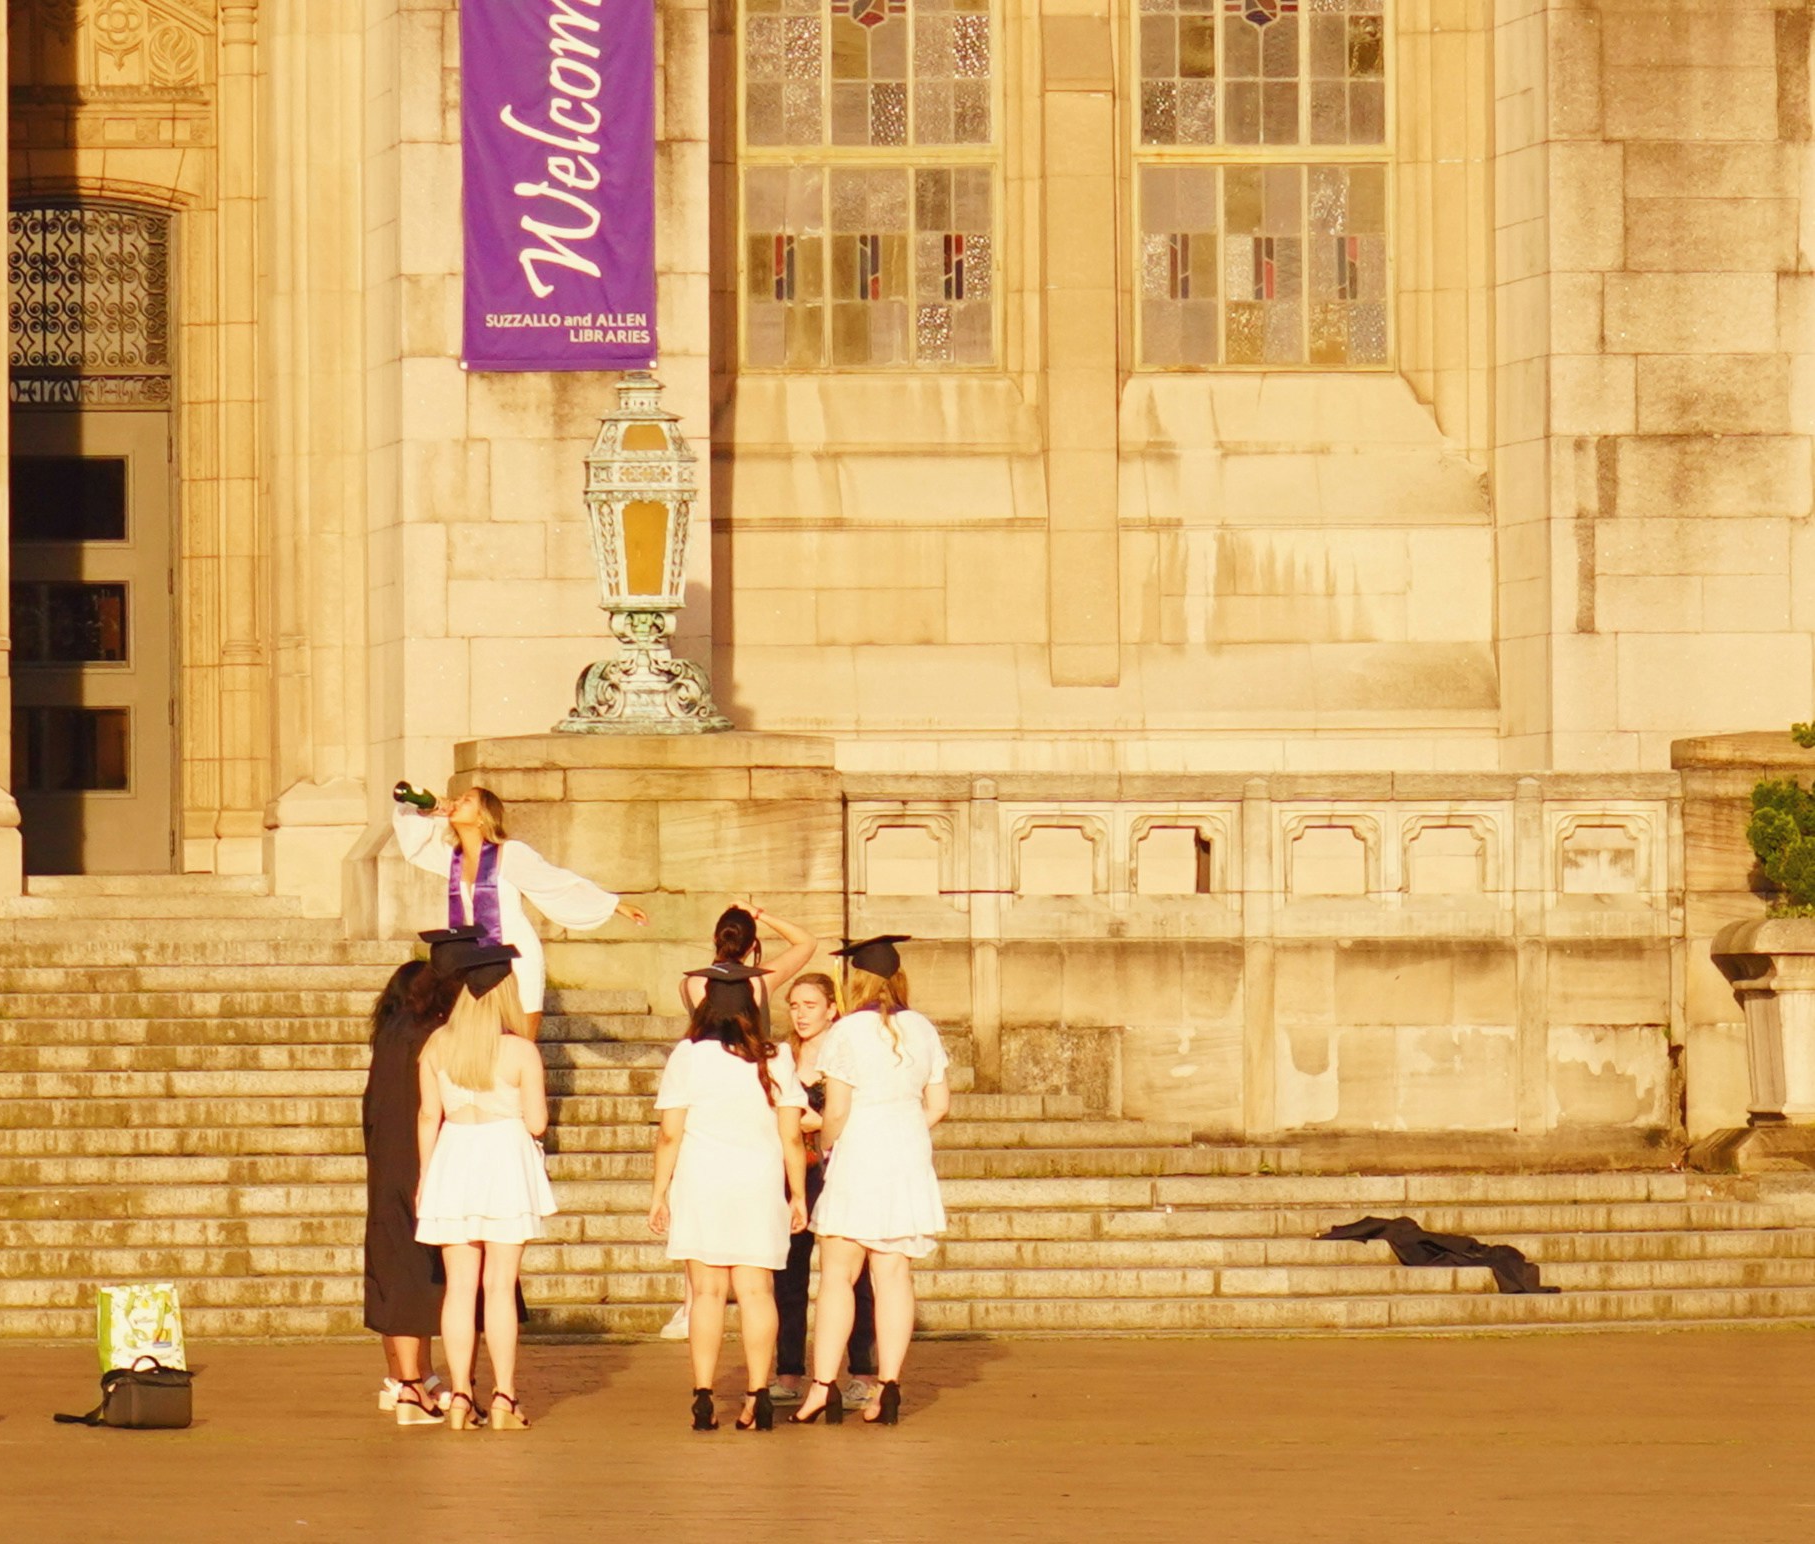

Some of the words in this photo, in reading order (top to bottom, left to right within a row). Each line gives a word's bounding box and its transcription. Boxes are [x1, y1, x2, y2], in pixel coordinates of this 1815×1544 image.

[485, 313, 561, 328] SUZZALLO
[563, 313, 592, 327] and
[595, 313, 647, 327] ALLEN
[569, 329, 651, 343] LIBRARIES
